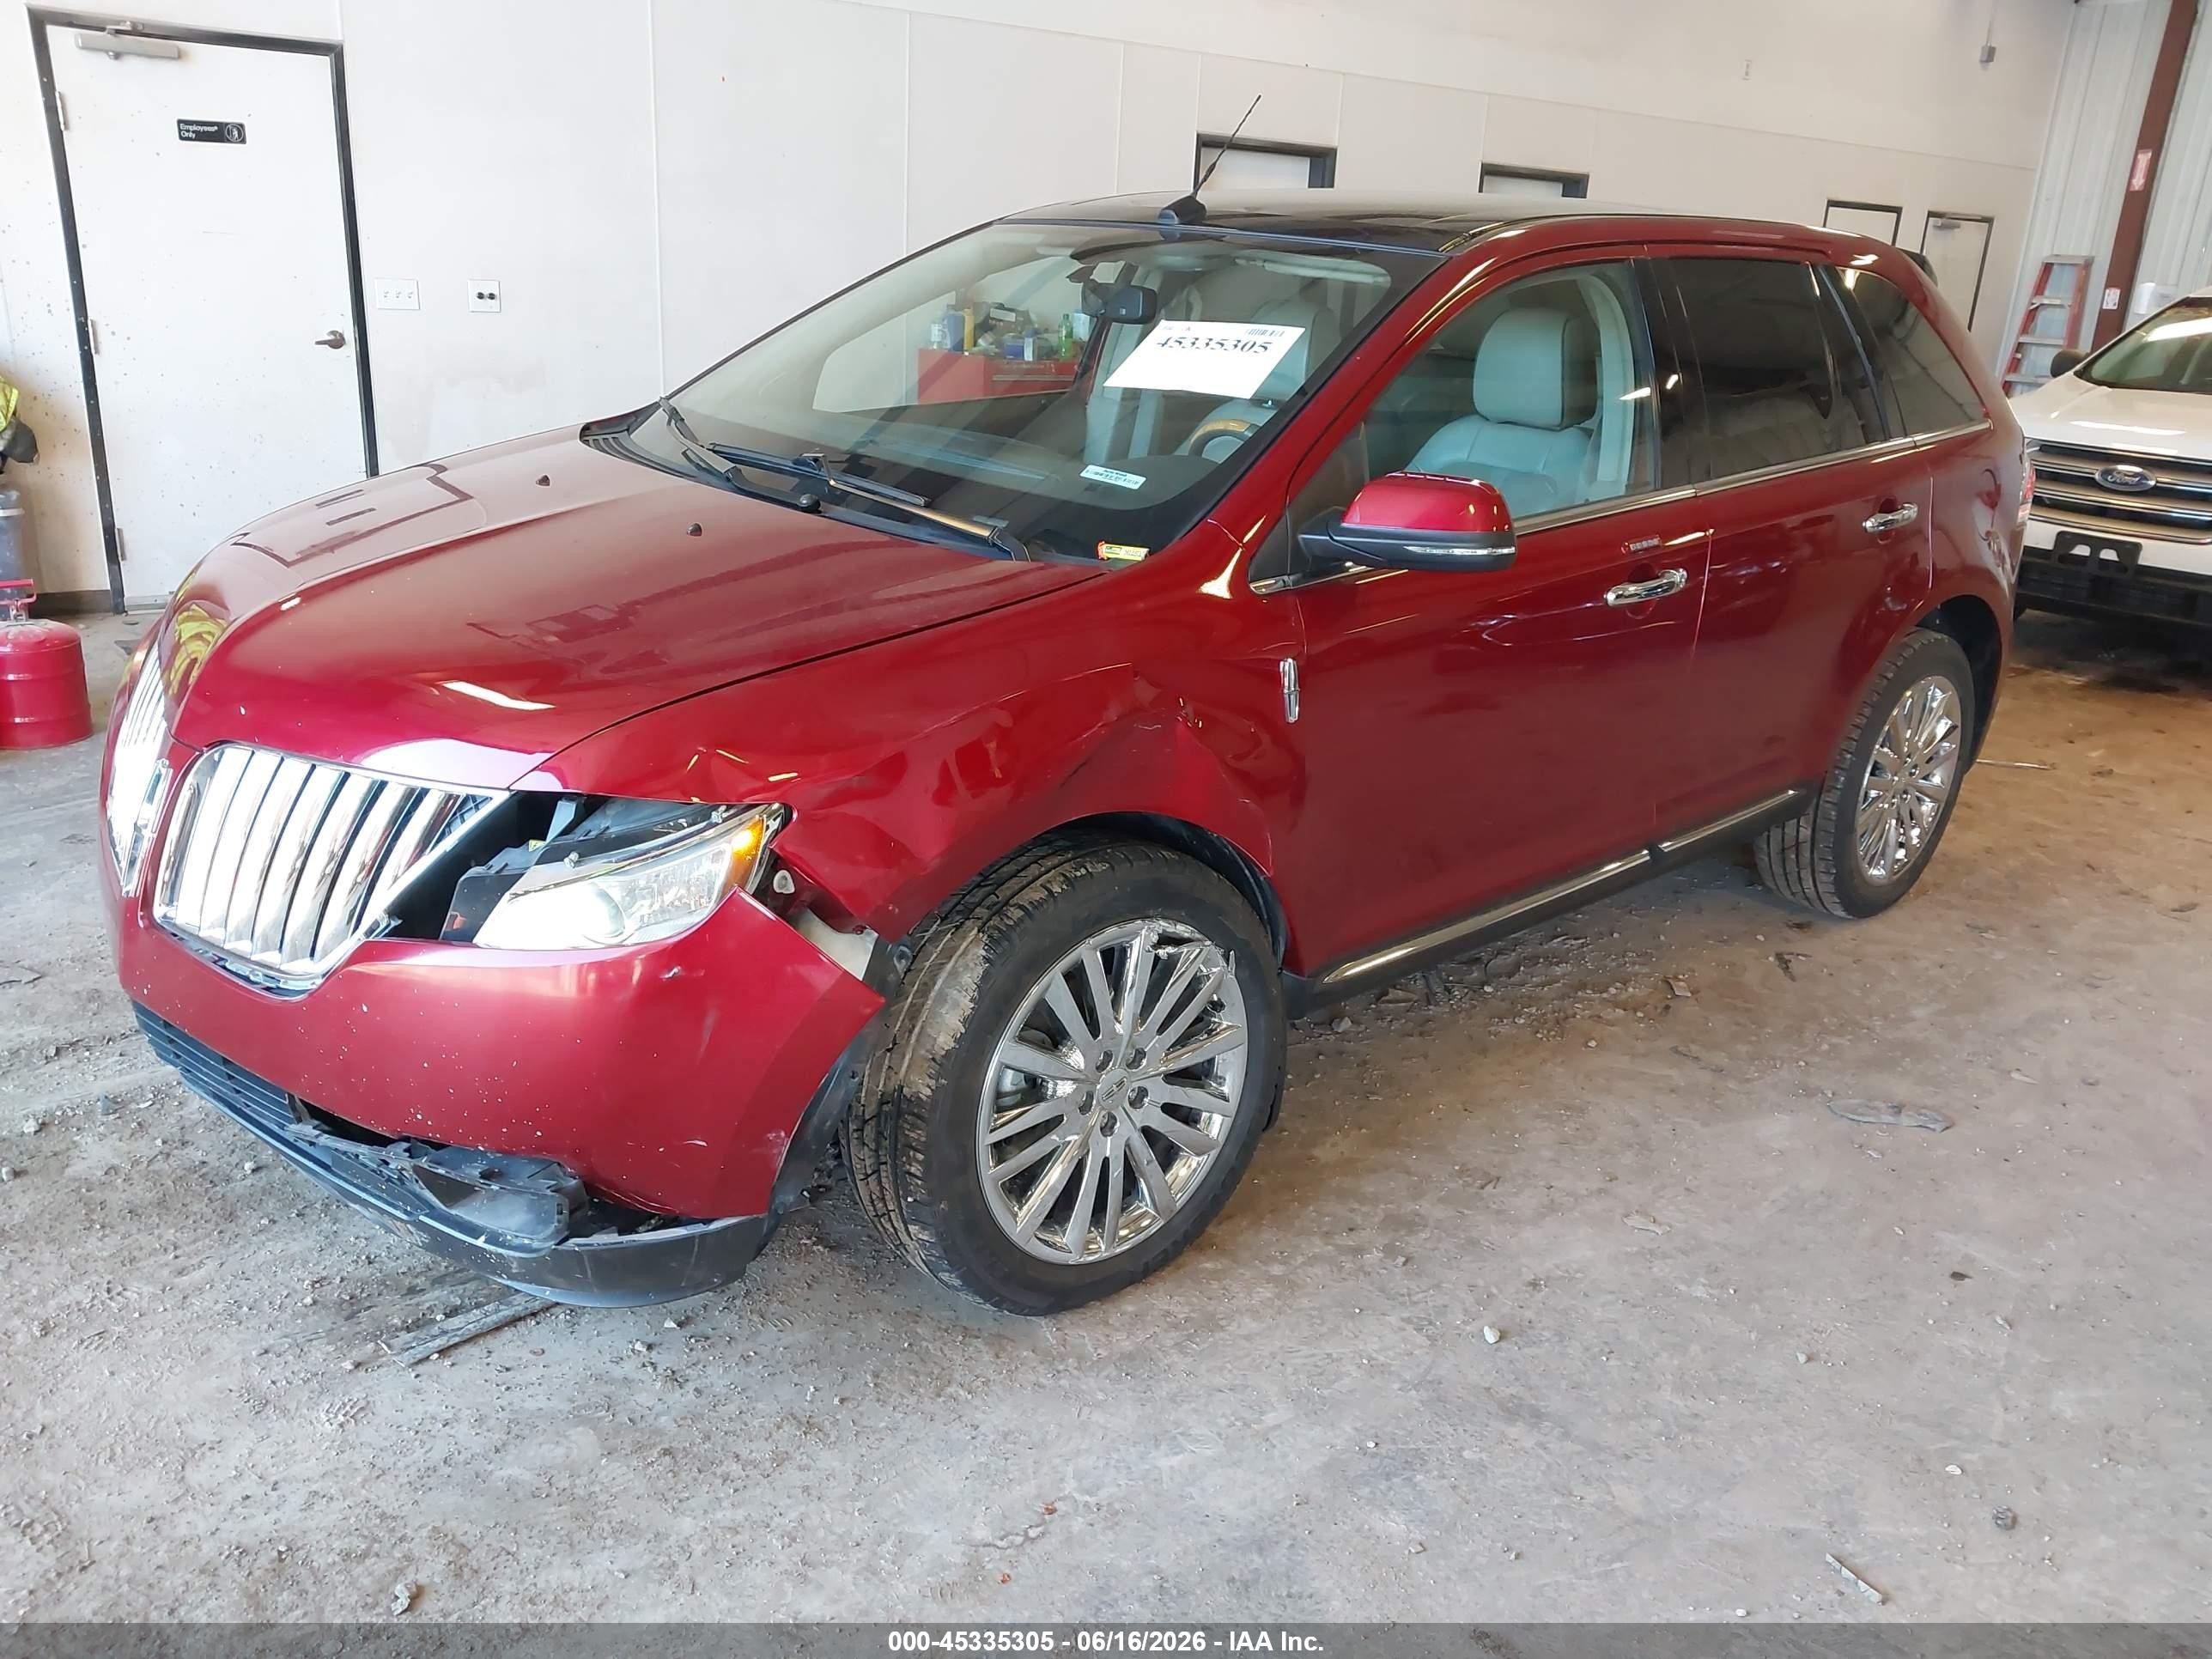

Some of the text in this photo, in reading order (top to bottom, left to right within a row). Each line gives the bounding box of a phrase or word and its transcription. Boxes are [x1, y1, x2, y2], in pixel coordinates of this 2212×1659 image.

[180, 130, 197, 139] Only
[1156, 336, 1273, 354] 45335305
[2106, 469, 2141, 485] Ford
